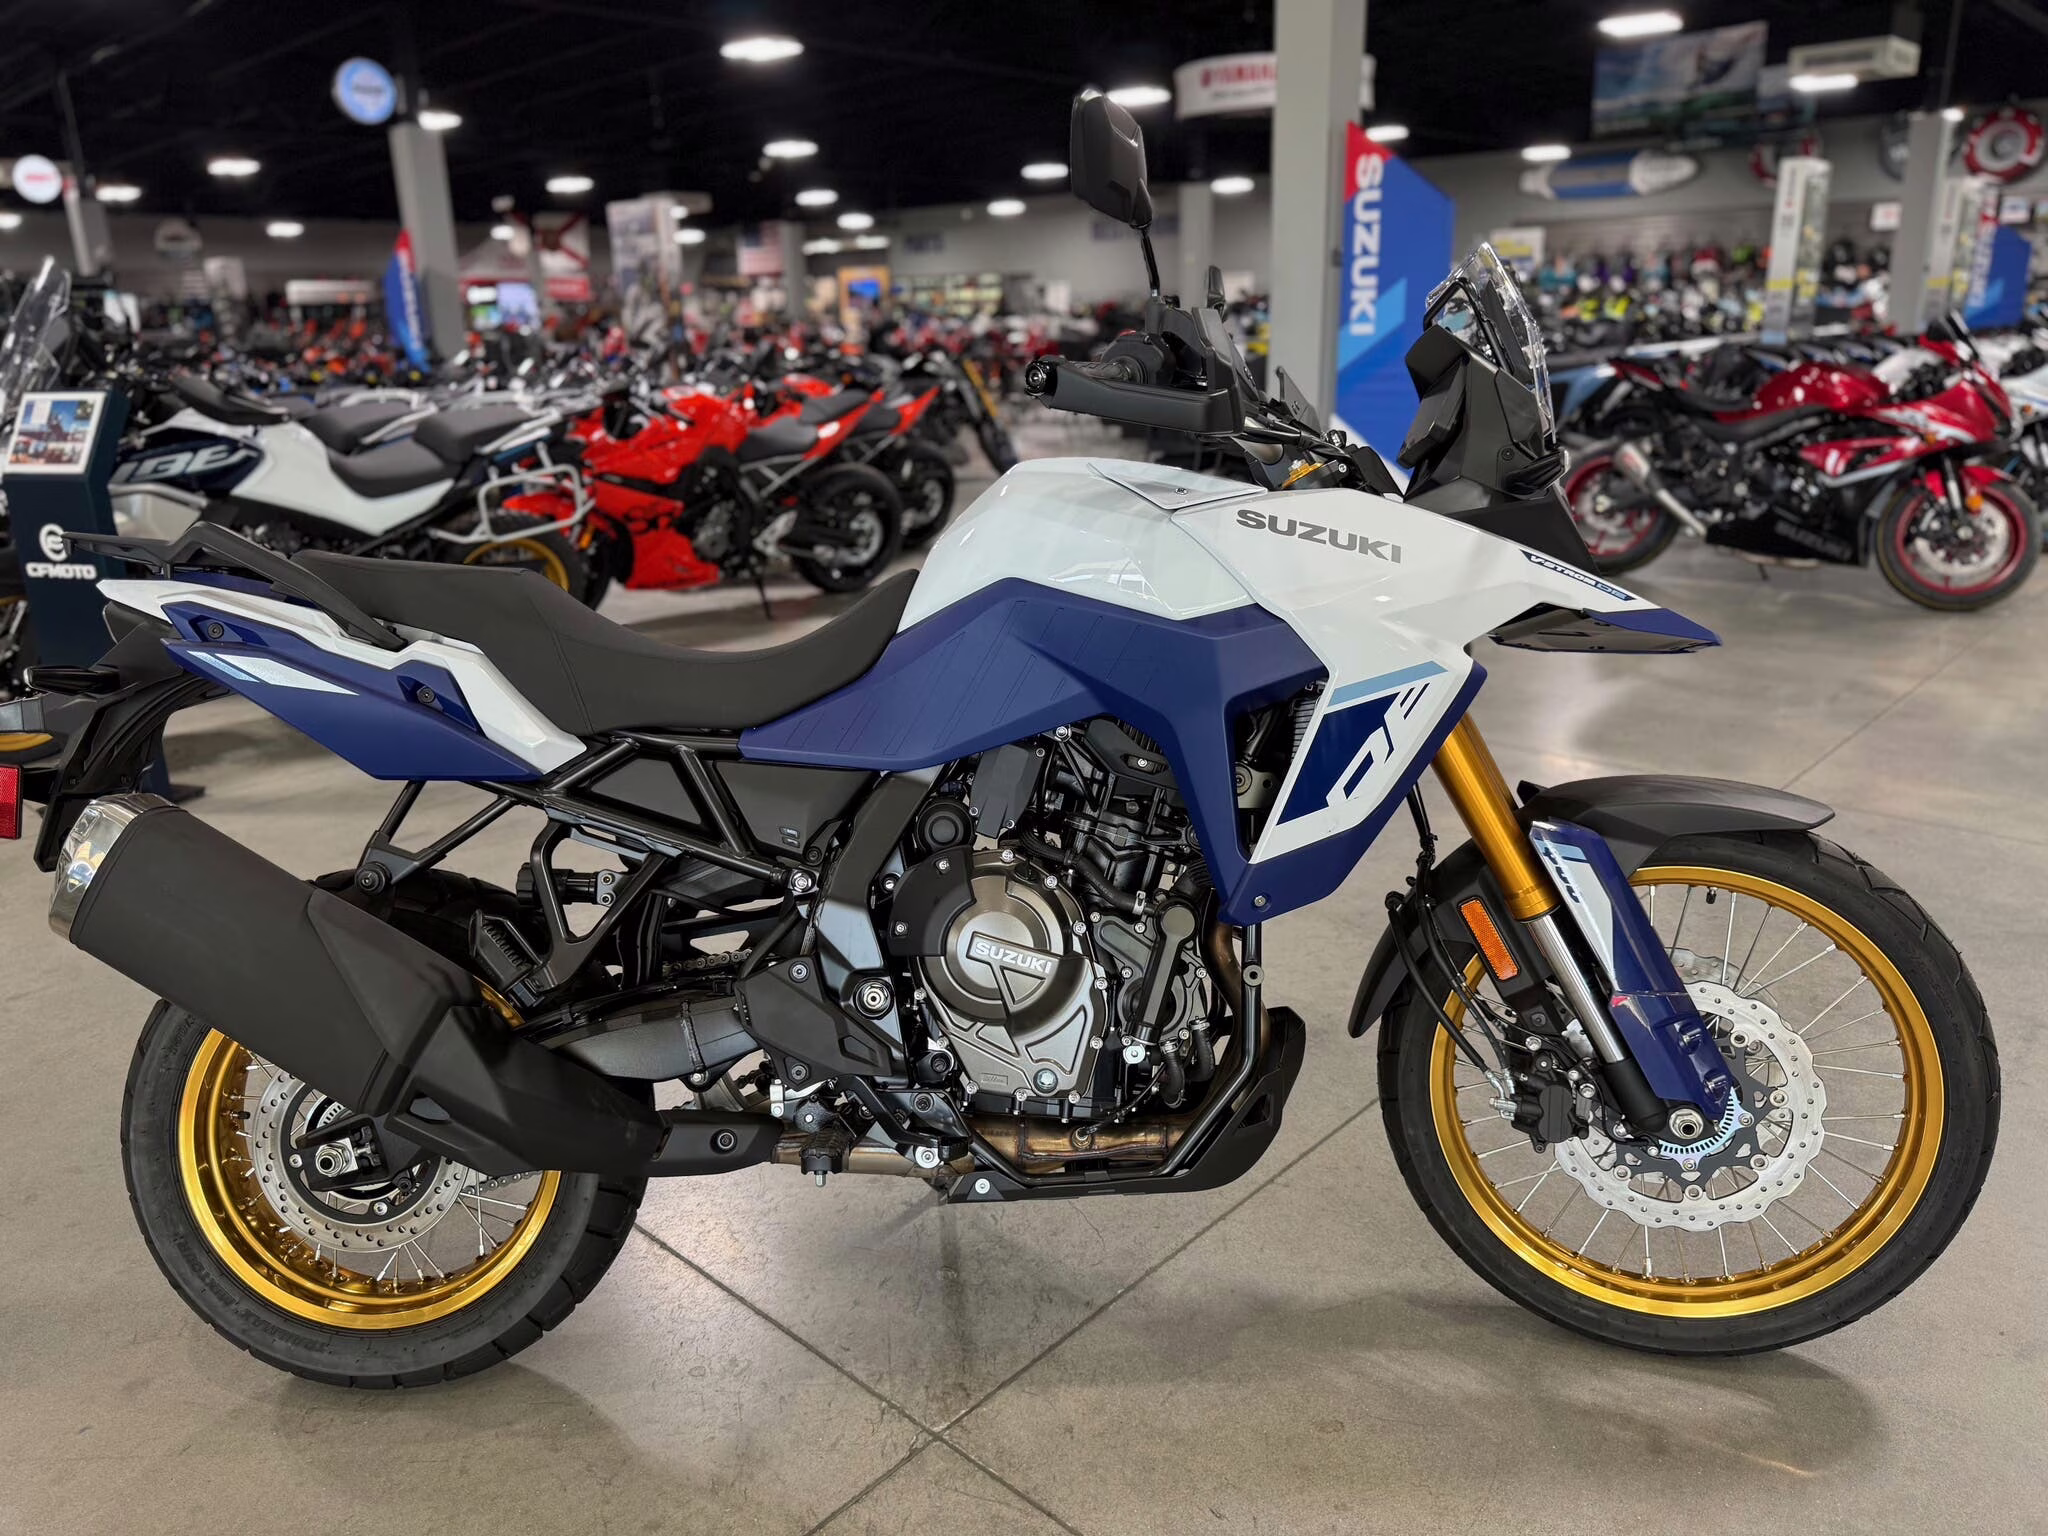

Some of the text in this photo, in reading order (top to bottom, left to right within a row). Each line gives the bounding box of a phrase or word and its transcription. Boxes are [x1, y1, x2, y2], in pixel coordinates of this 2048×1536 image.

[1349, 152, 1384, 337] SUZUKI
[1236, 509, 1402, 564] SUZUKI
[25, 562, 98, 579] CFMOTO
[975, 941, 1052, 975] SUZUKI
